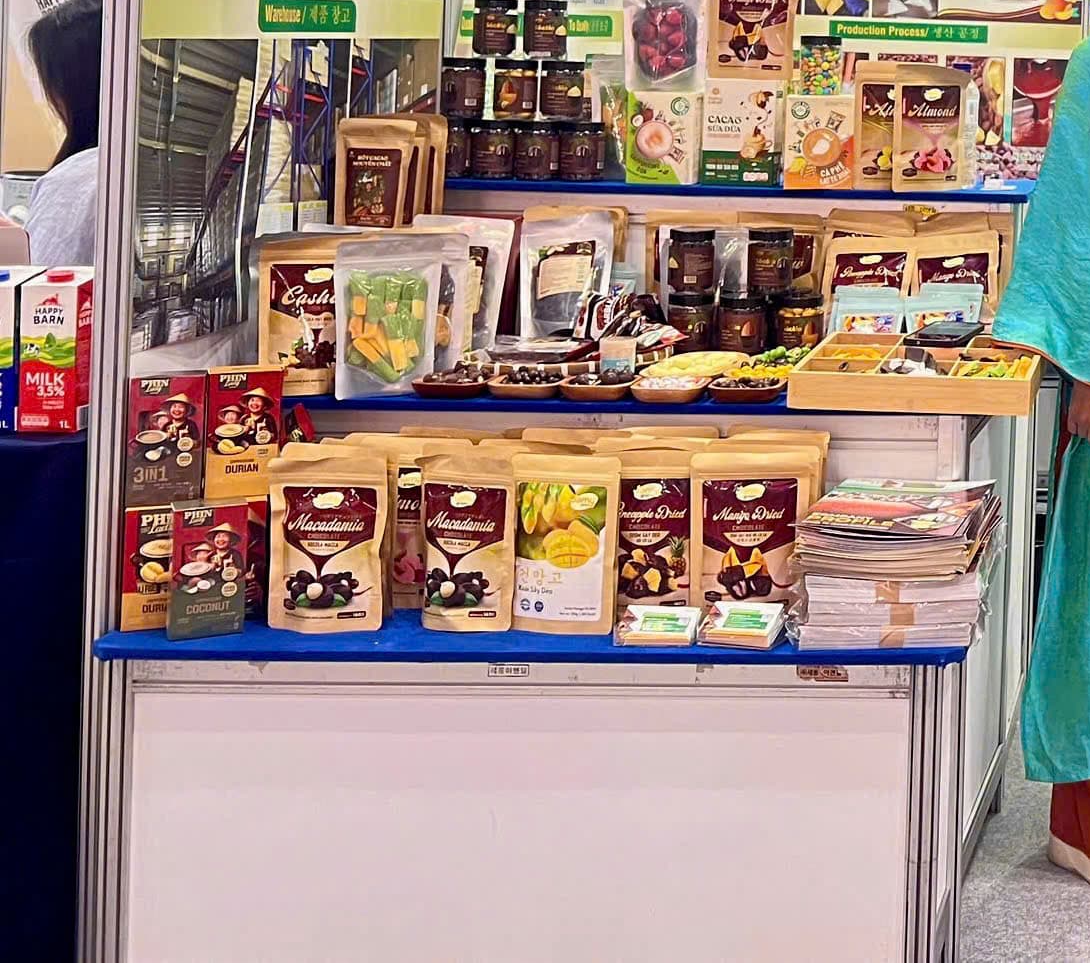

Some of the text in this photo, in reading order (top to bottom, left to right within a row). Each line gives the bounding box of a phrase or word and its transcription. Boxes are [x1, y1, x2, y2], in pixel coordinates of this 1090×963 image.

[265, 4, 301, 23] Warehouse
[837, 23, 886, 36] Production
[908, 102, 958, 118] Almond
[707, 115, 743, 125] CACAO
[281, 284, 336, 308] Cash
[35, 307, 64, 316] HAPPY
[33, 315, 65, 326] BARN
[25, 372, 65, 386] MILK
[141, 379, 170, 388] PHIN
[219, 374, 247, 383] PHIN
[59, 420, 71, 429] 1L
[133, 466, 168, 484] 3IN1
[225, 463, 259, 474] DURIAN
[183, 509, 213, 520] PHIN
[655, 505, 687, 520] Dried
[751, 505, 786, 520] Dried
[287, 512, 365, 533] Macadamia
[426, 510, 496, 533] Macadamia
[186, 600, 231, 615] COCONUT
